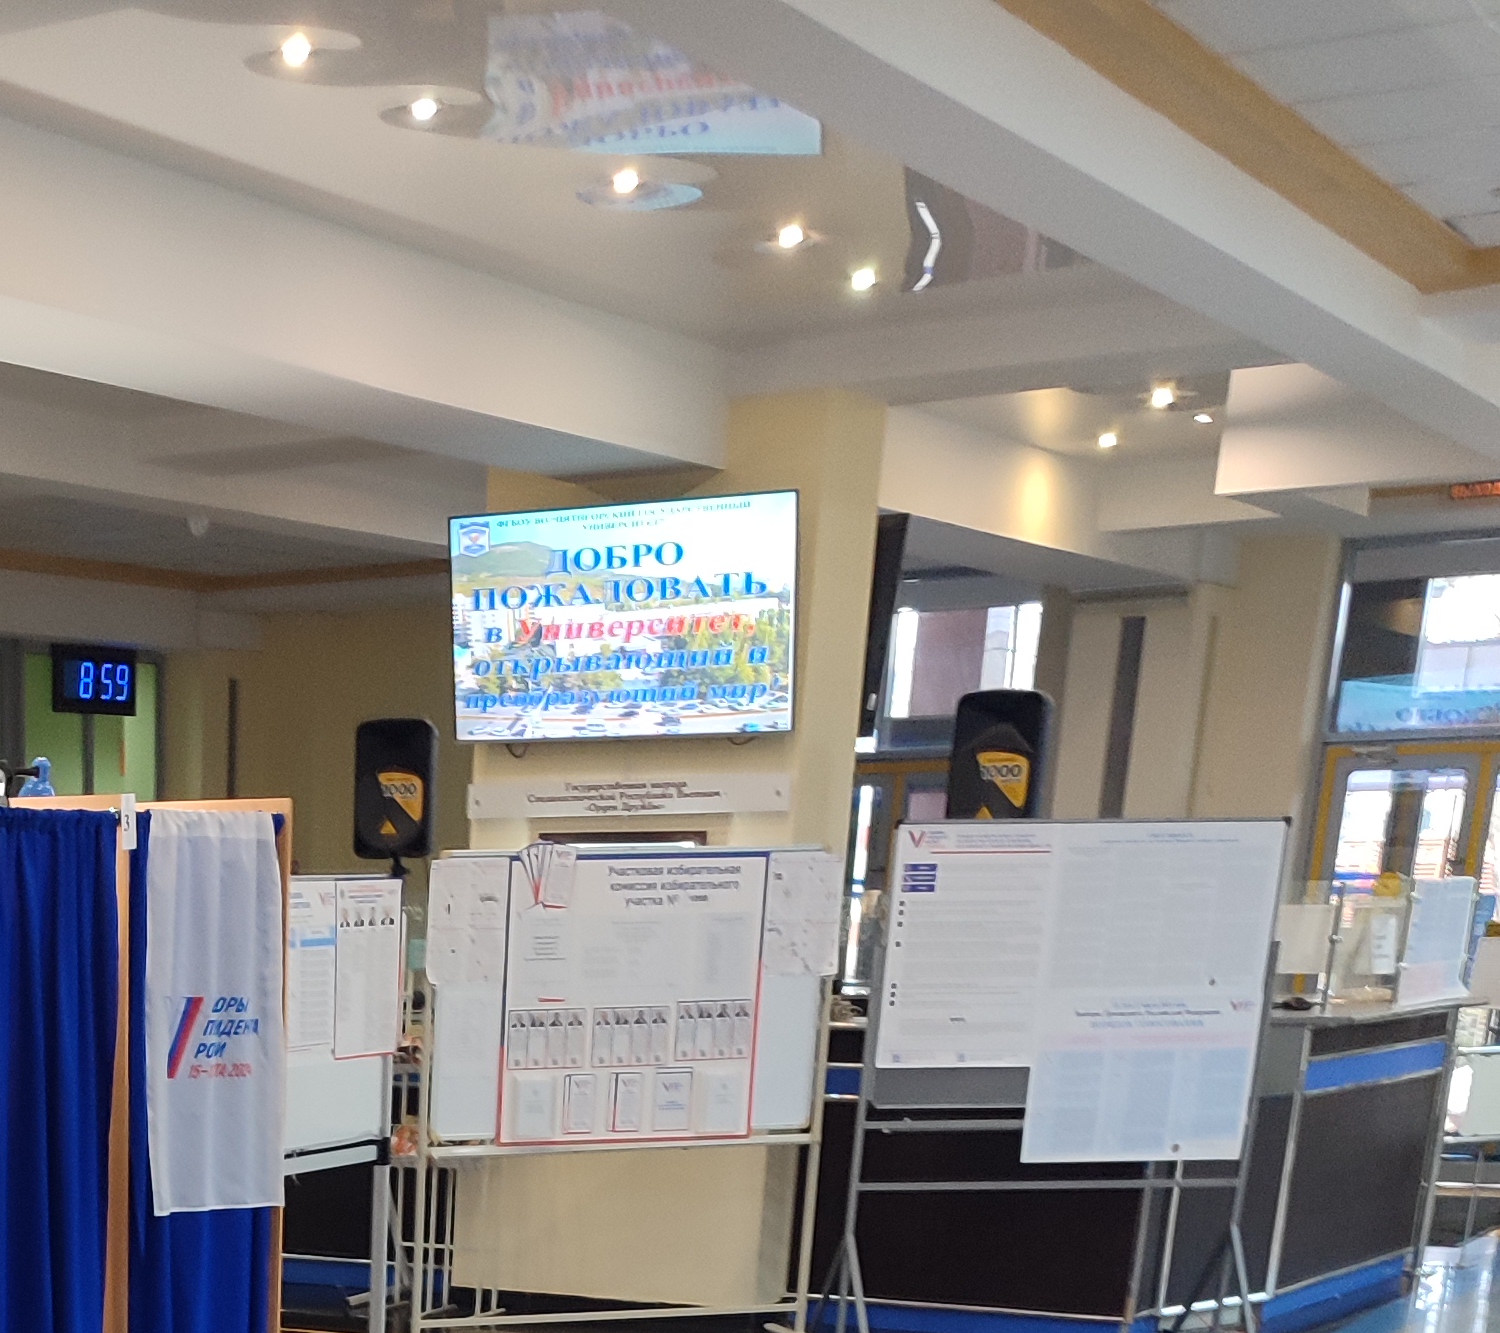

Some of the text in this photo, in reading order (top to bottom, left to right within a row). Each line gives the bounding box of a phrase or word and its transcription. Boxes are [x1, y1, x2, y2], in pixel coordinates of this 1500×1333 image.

[545, 540, 685, 579] ДОБРО
[471, 571, 769, 612] ПОЖАЛОВАТЬ
[516, 612, 757, 645] Университет,
[472, 645, 770, 680] открывающий и
[123, 813, 131, 832] 3
